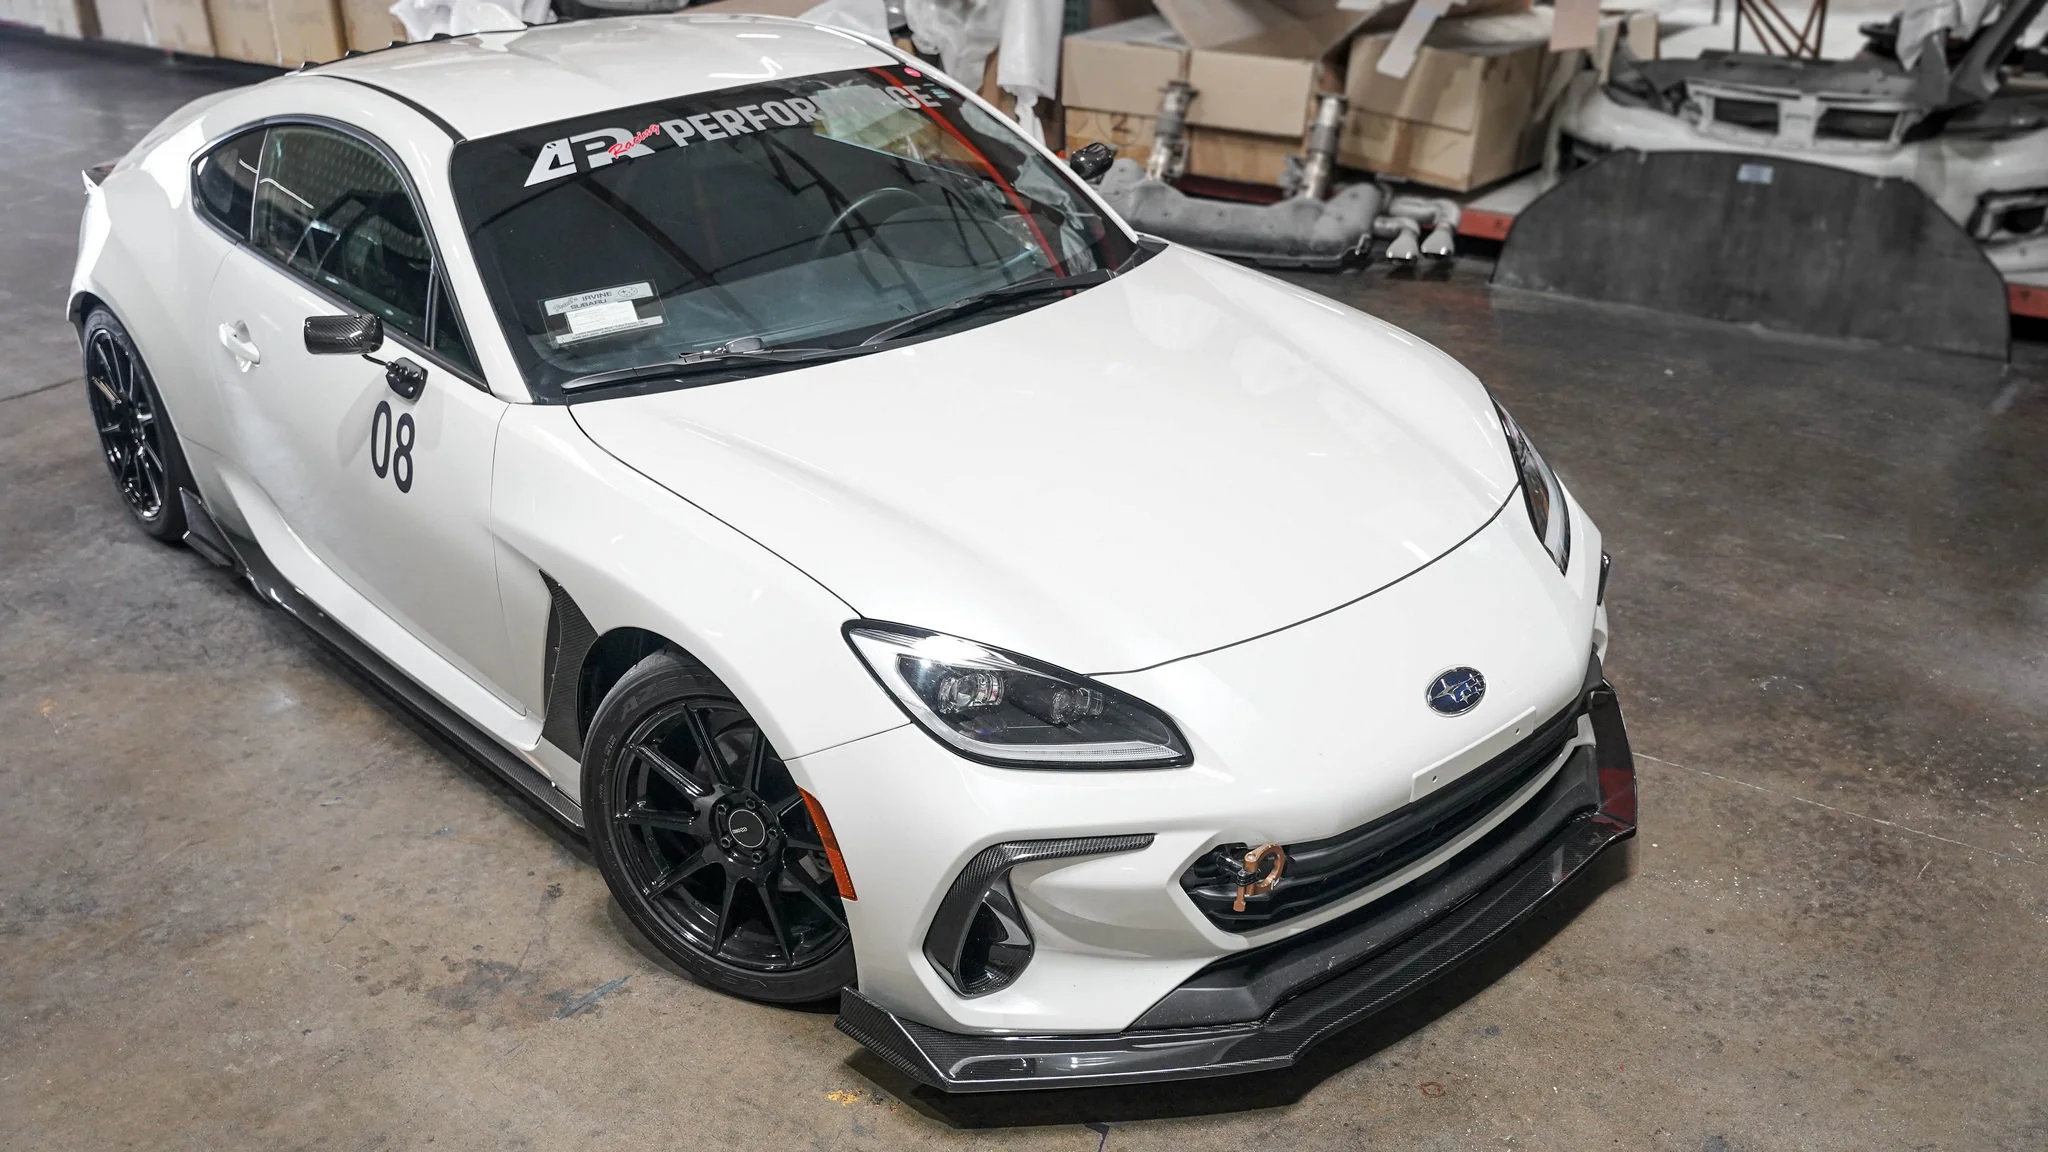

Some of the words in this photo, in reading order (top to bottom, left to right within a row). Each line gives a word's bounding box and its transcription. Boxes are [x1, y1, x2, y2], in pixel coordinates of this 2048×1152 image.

[607, 123, 660, 159] Racing
[659, 85, 942, 148] PERFORCE
[570, 299, 607, 310] SUBARU
[581, 291, 612, 301] IRVINE
[371, 400, 415, 493] 08
